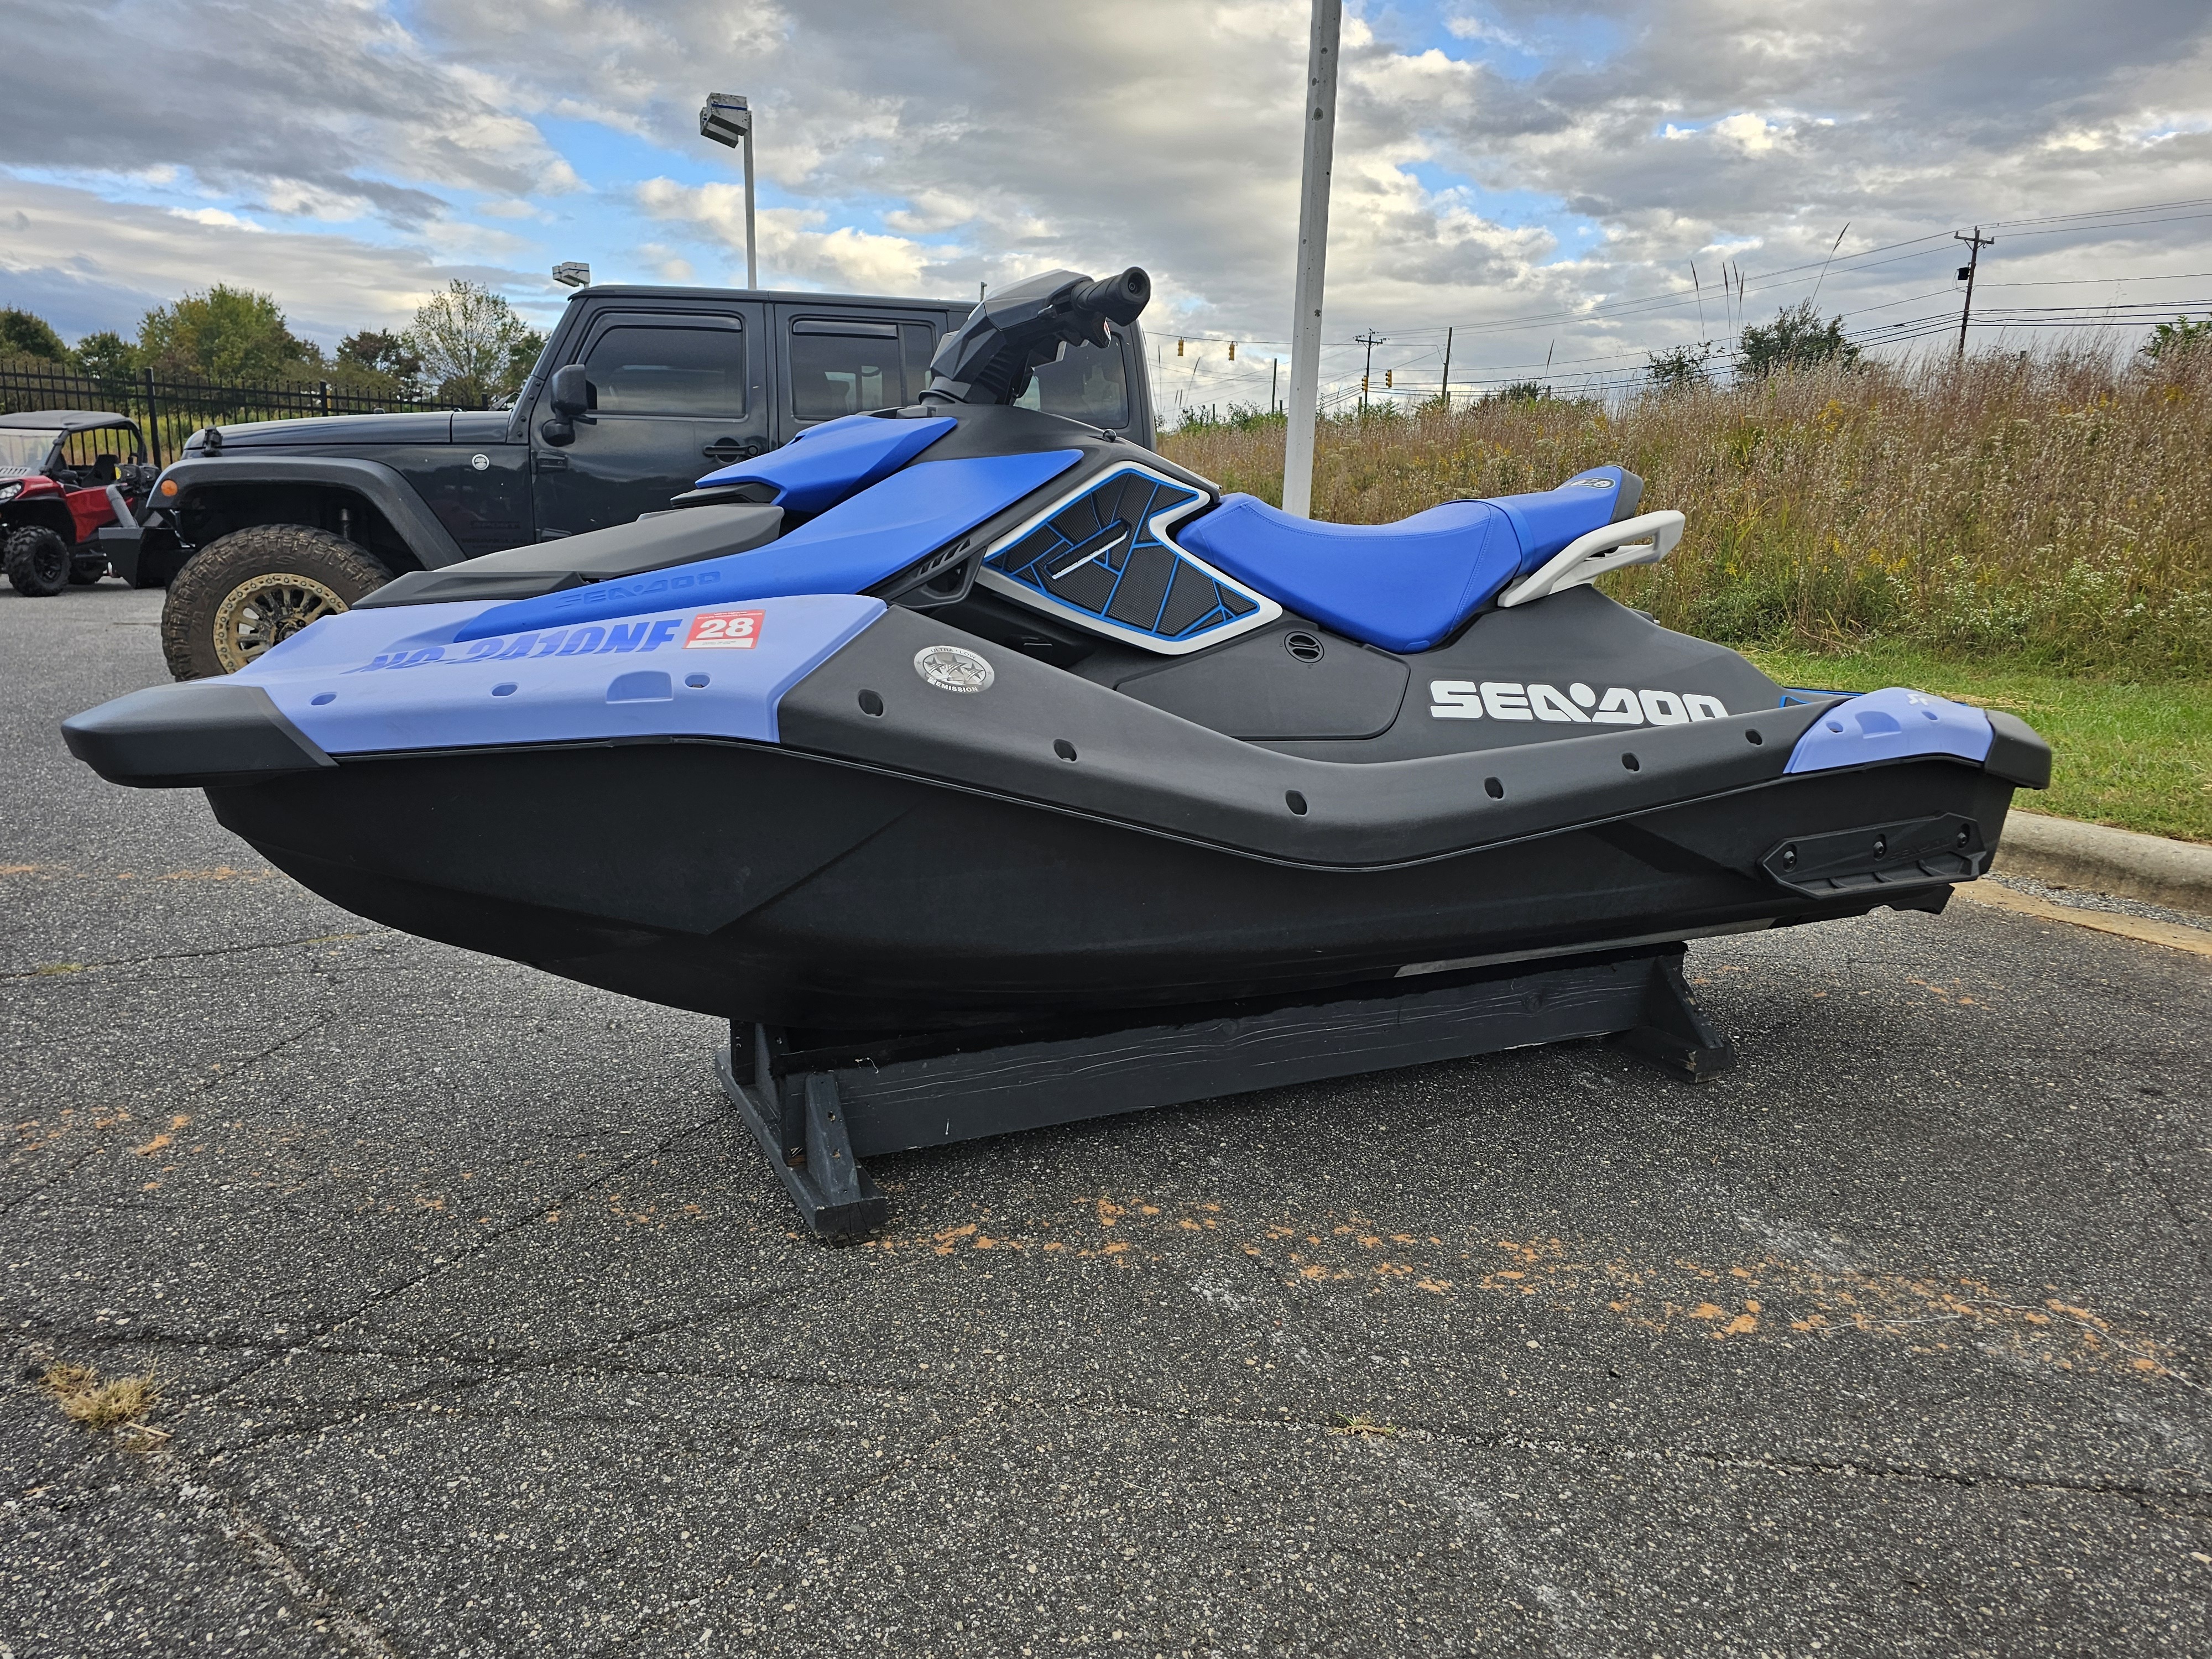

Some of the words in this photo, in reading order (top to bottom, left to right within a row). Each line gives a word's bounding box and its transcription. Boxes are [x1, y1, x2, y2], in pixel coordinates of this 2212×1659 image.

[696, 617, 754, 639] 28
[959, 650, 977, 659] LOW
[936, 682, 978, 692] EMISSION
